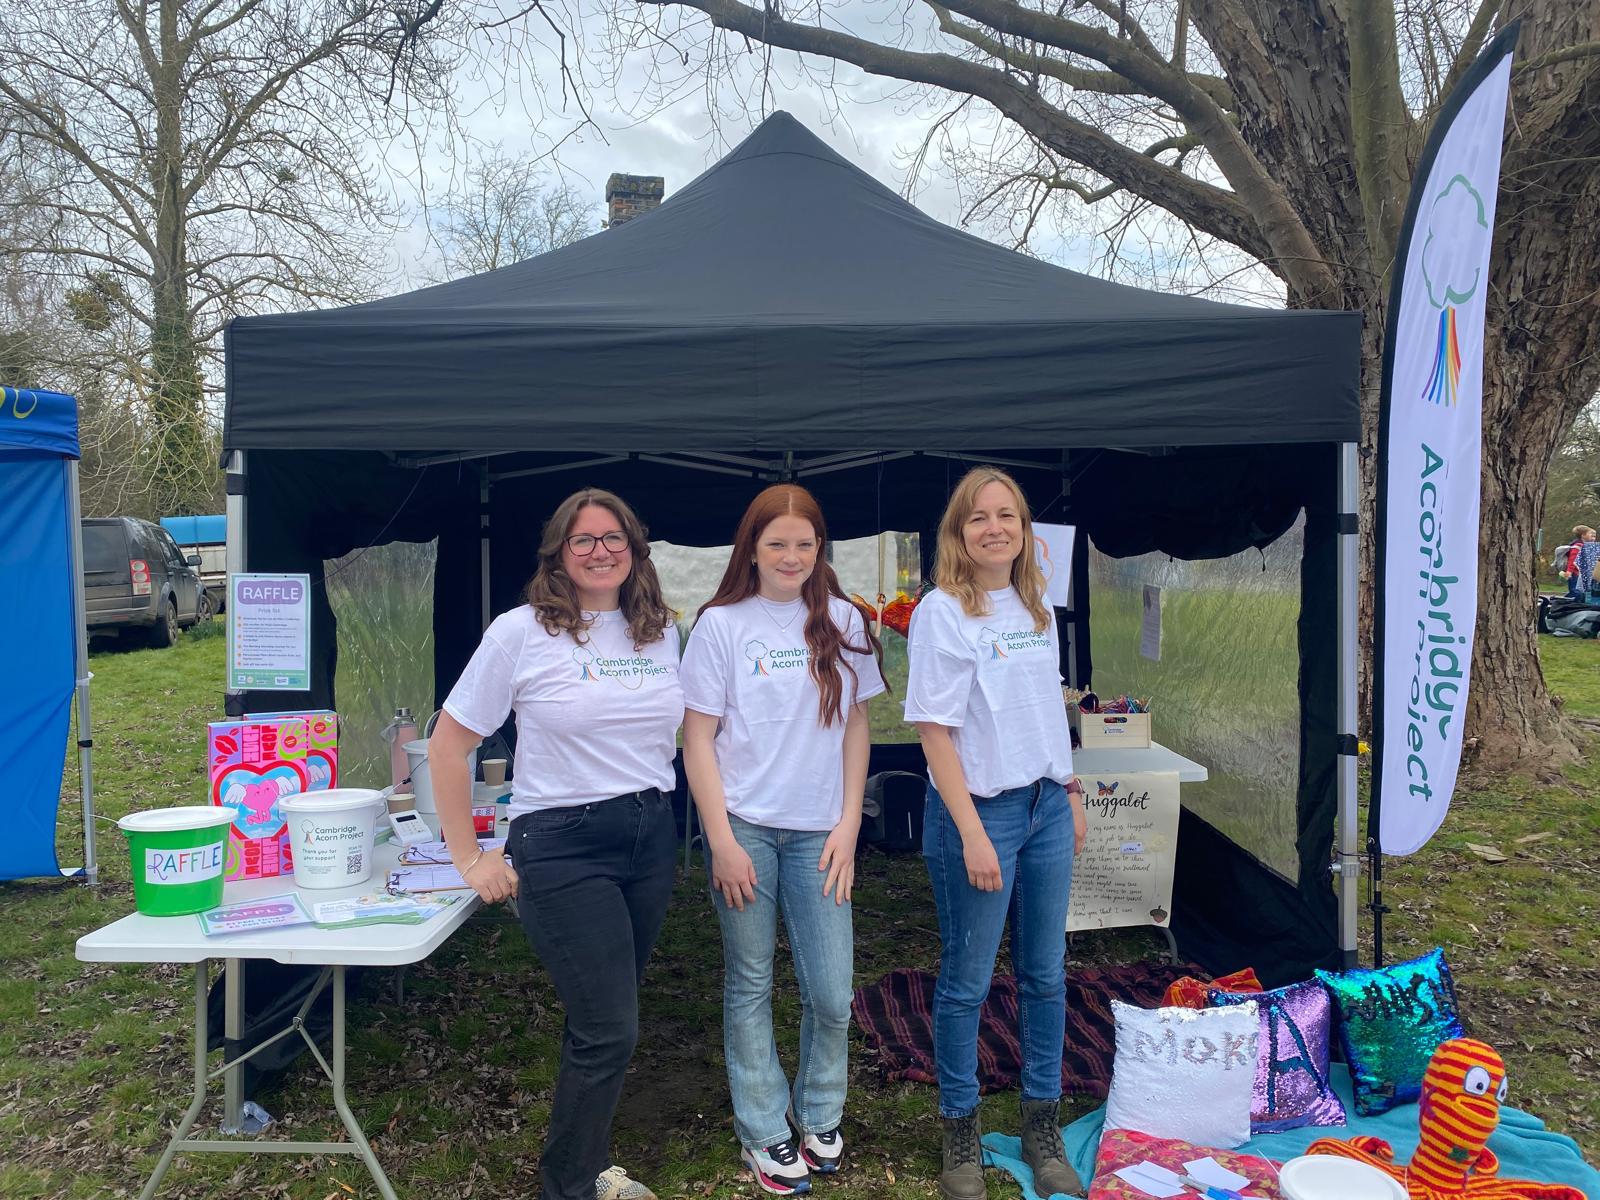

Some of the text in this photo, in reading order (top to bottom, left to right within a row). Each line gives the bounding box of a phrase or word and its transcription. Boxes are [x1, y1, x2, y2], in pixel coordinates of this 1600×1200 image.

[242, 587, 299, 600] RAFFLE
[1425, 463, 1466, 741] bridg
[1007, 639, 1052, 651] Acorn Proj
[769, 647, 813, 658] Cambri
[595, 656, 654, 667] Cambridge
[771, 659, 804, 669] Acorn
[599, 666, 669, 677] Acorn Project
[314, 826, 357, 834] Cambridge
[315, 831, 364, 842] Acorn Project
[147, 846, 221, 880] RAFFLE
[214, 907, 290, 919] RAFFLE
[1266, 1003, 1326, 1115] A
